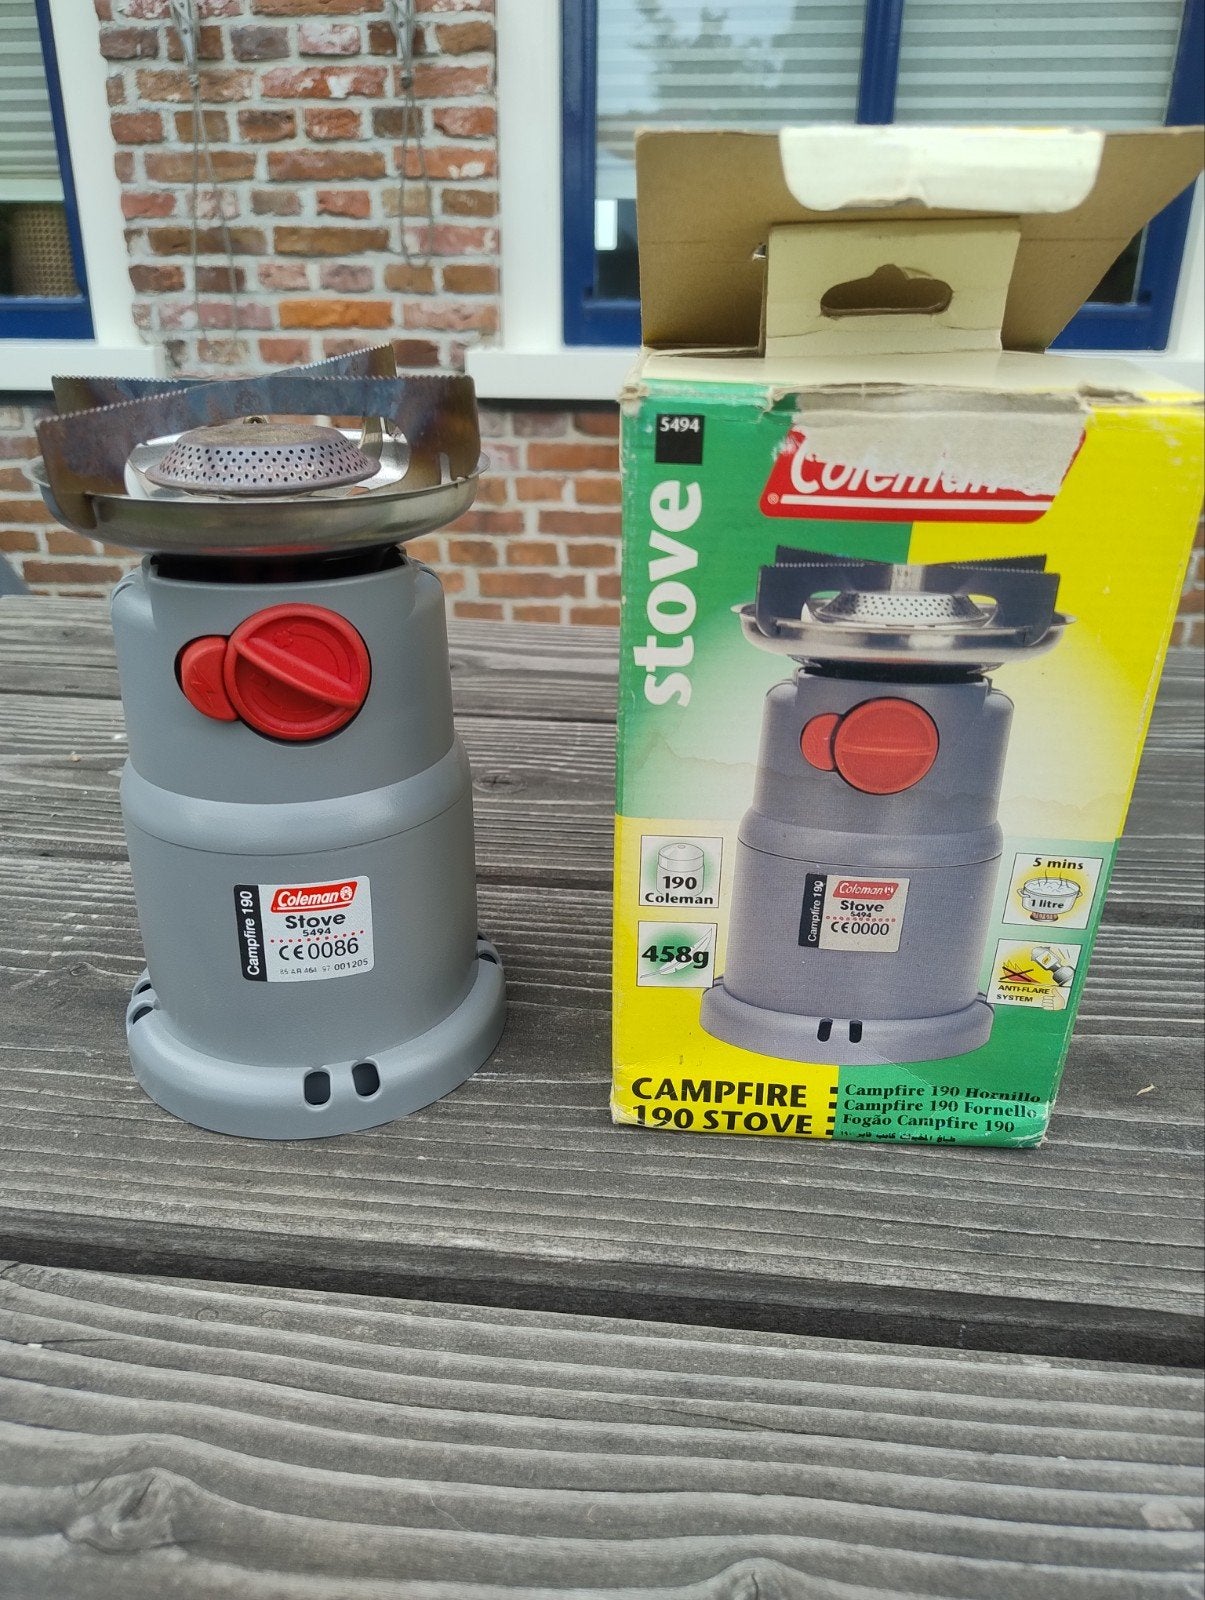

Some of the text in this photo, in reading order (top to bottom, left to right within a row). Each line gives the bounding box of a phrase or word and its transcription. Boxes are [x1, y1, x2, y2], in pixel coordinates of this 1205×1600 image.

[659, 417, 700, 434] 5494
[633, 479, 702, 707] stove
[1032, 857, 1084, 870] 5 mins
[662, 875, 697, 890] 190
[839, 882, 883, 895] Coleman
[278, 890, 339, 908] Coleman
[645, 892, 714, 905] Coleman
[840, 900, 885, 912] Stove
[1030, 899, 1065, 909] 1 litre
[808, 880, 824, 942] Campfire 190
[285, 913, 346, 930] Stove
[239, 890, 261, 975] Campfire 190
[302, 927, 332, 937] 5494
[641, 945, 709, 969] 458g
[996, 994, 1033, 1002] SYSTEM
[997, 985, 1050, 995] ANTI-FLARE
[631, 1077, 807, 1108] CAMPFIRE
[845, 1084, 1041, 1104] Campfire 190 Hornillo
[844, 1099, 1037, 1119] Campfire 190 Fornello
[632, 1105, 813, 1135] 190 STOVE
[842, 1114, 1015, 1133] Fogão Campfire 190
